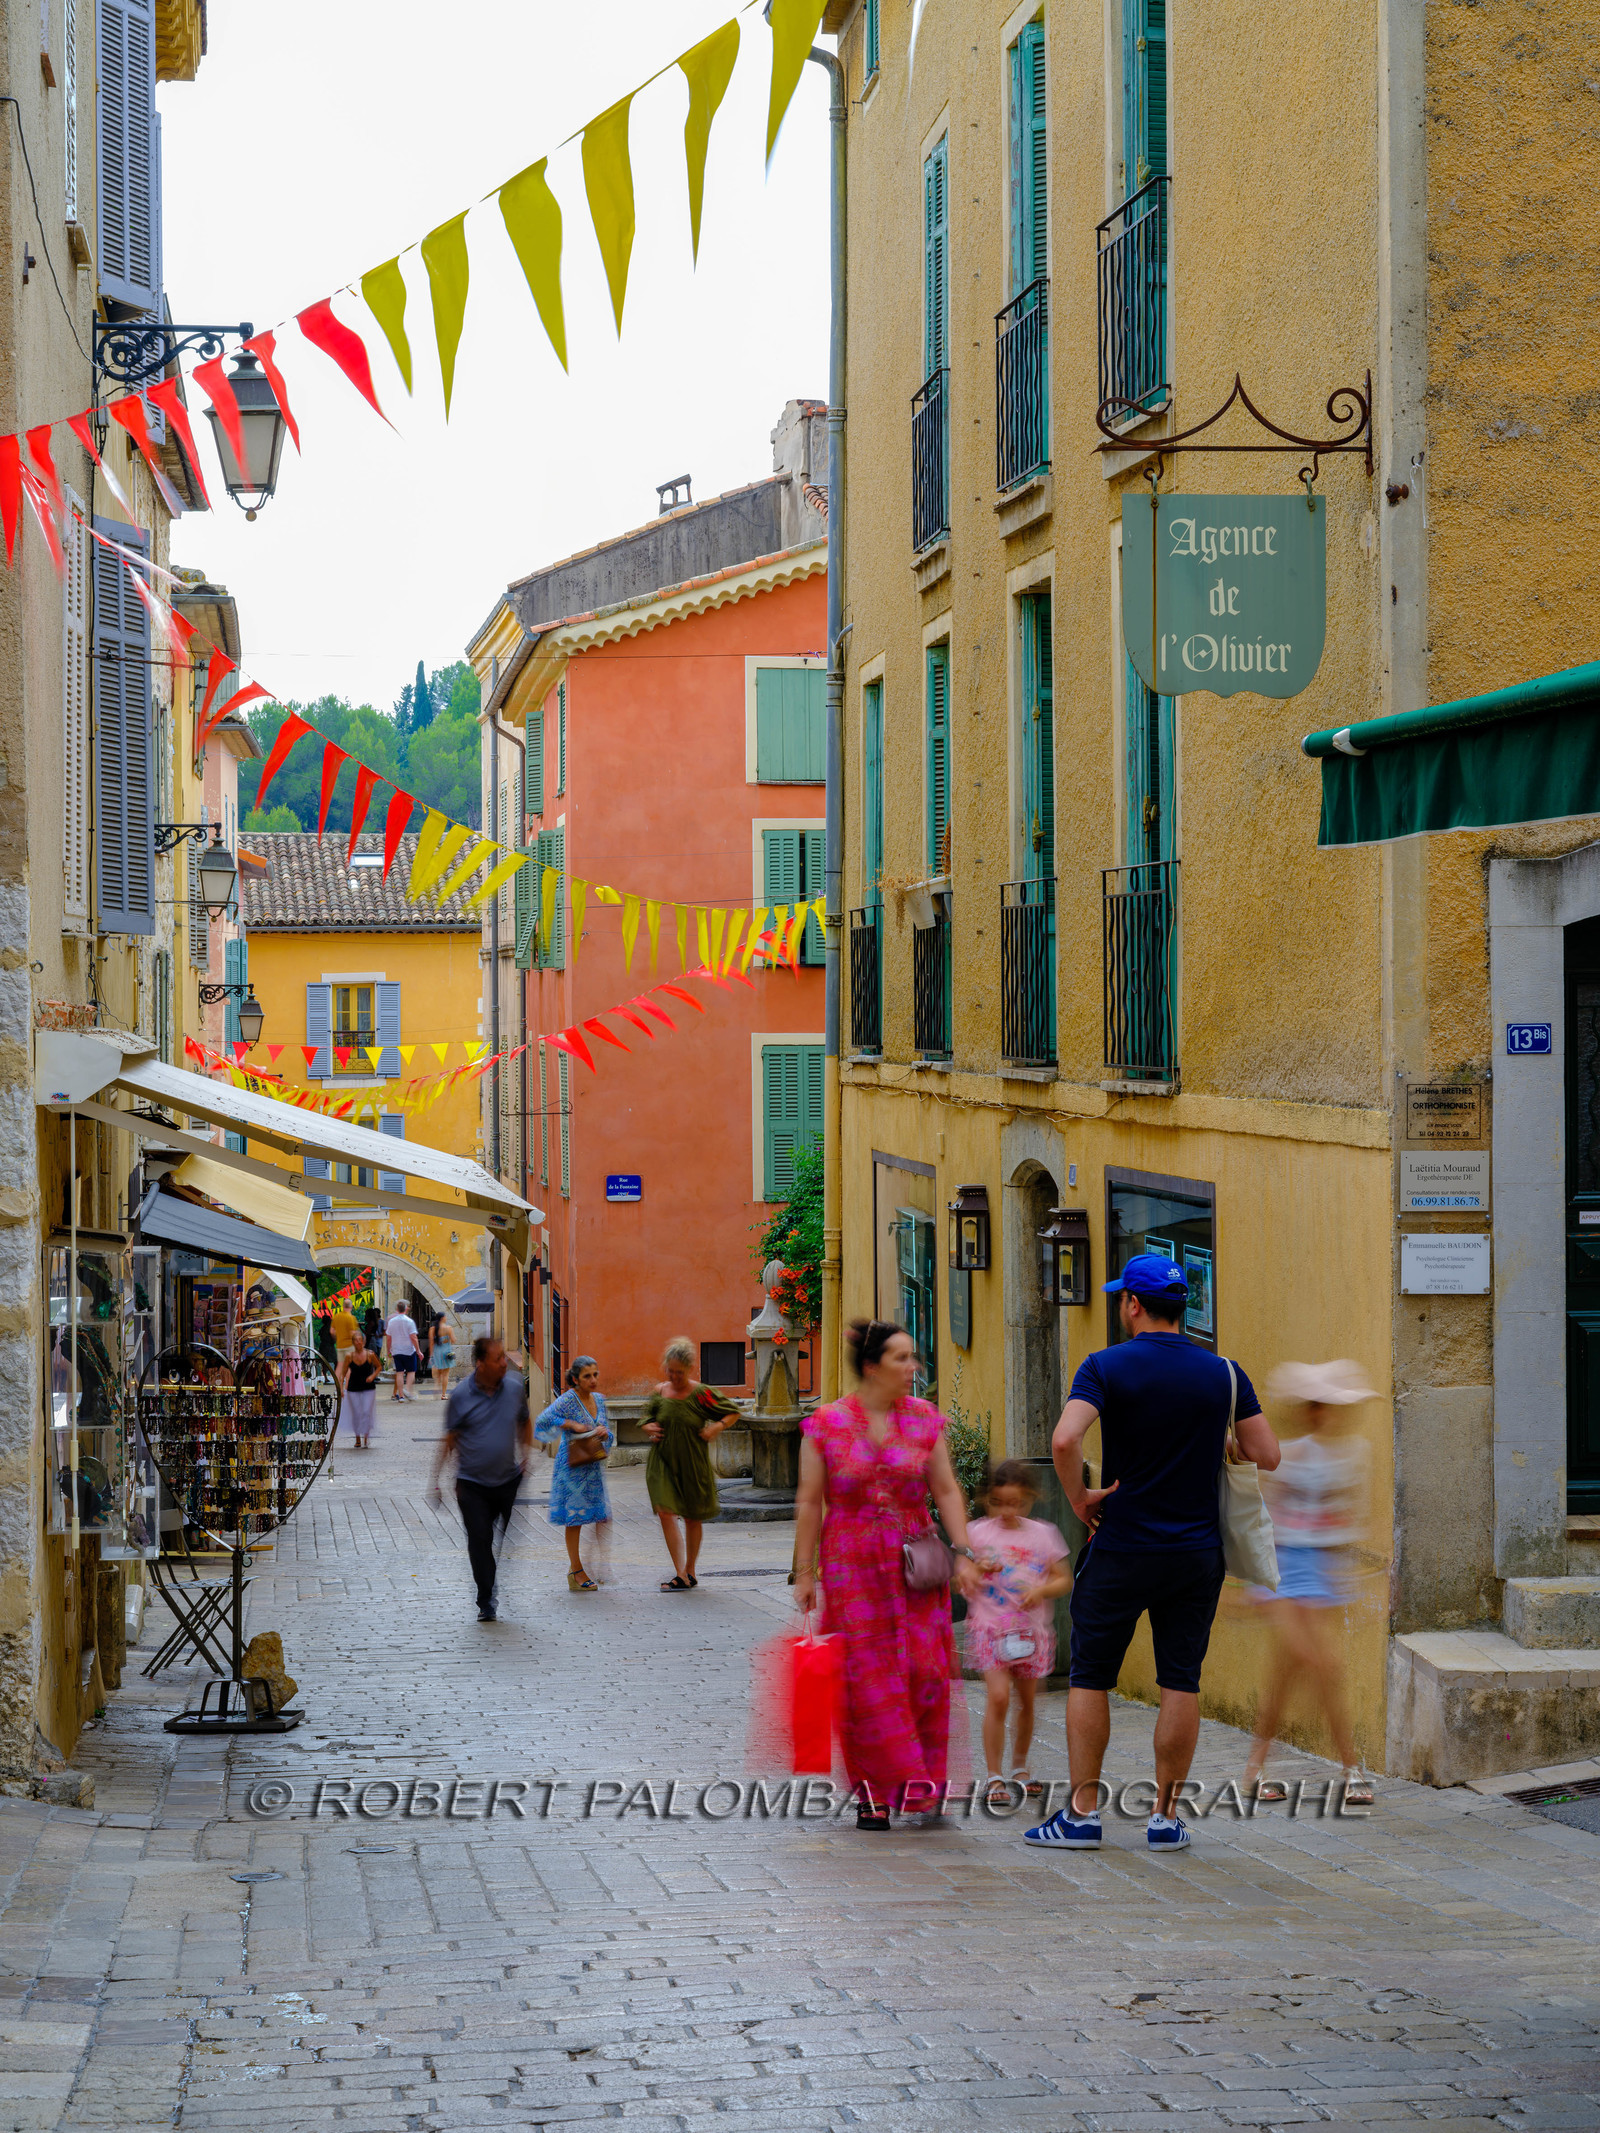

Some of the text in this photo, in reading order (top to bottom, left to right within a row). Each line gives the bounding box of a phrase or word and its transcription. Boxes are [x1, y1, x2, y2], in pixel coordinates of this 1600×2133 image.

[1169, 518, 1279, 565] Agence
[1209, 577, 1241, 617] de
[1160, 633, 1291, 673] l'Olivier
[1511, 1029, 1547, 1049] 13 Bis
[1415, 1087, 1473, 1095] Hélène BRETHES
[1412, 1102, 1476, 1110] ORTHOPHONISTE
[1409, 1164, 1481, 1173] Laëtitia Mouraud
[1417, 1174, 1462, 1182] Ergothérapeute
[1411, 1197, 1480, 1206] 06.99.81.86.78
